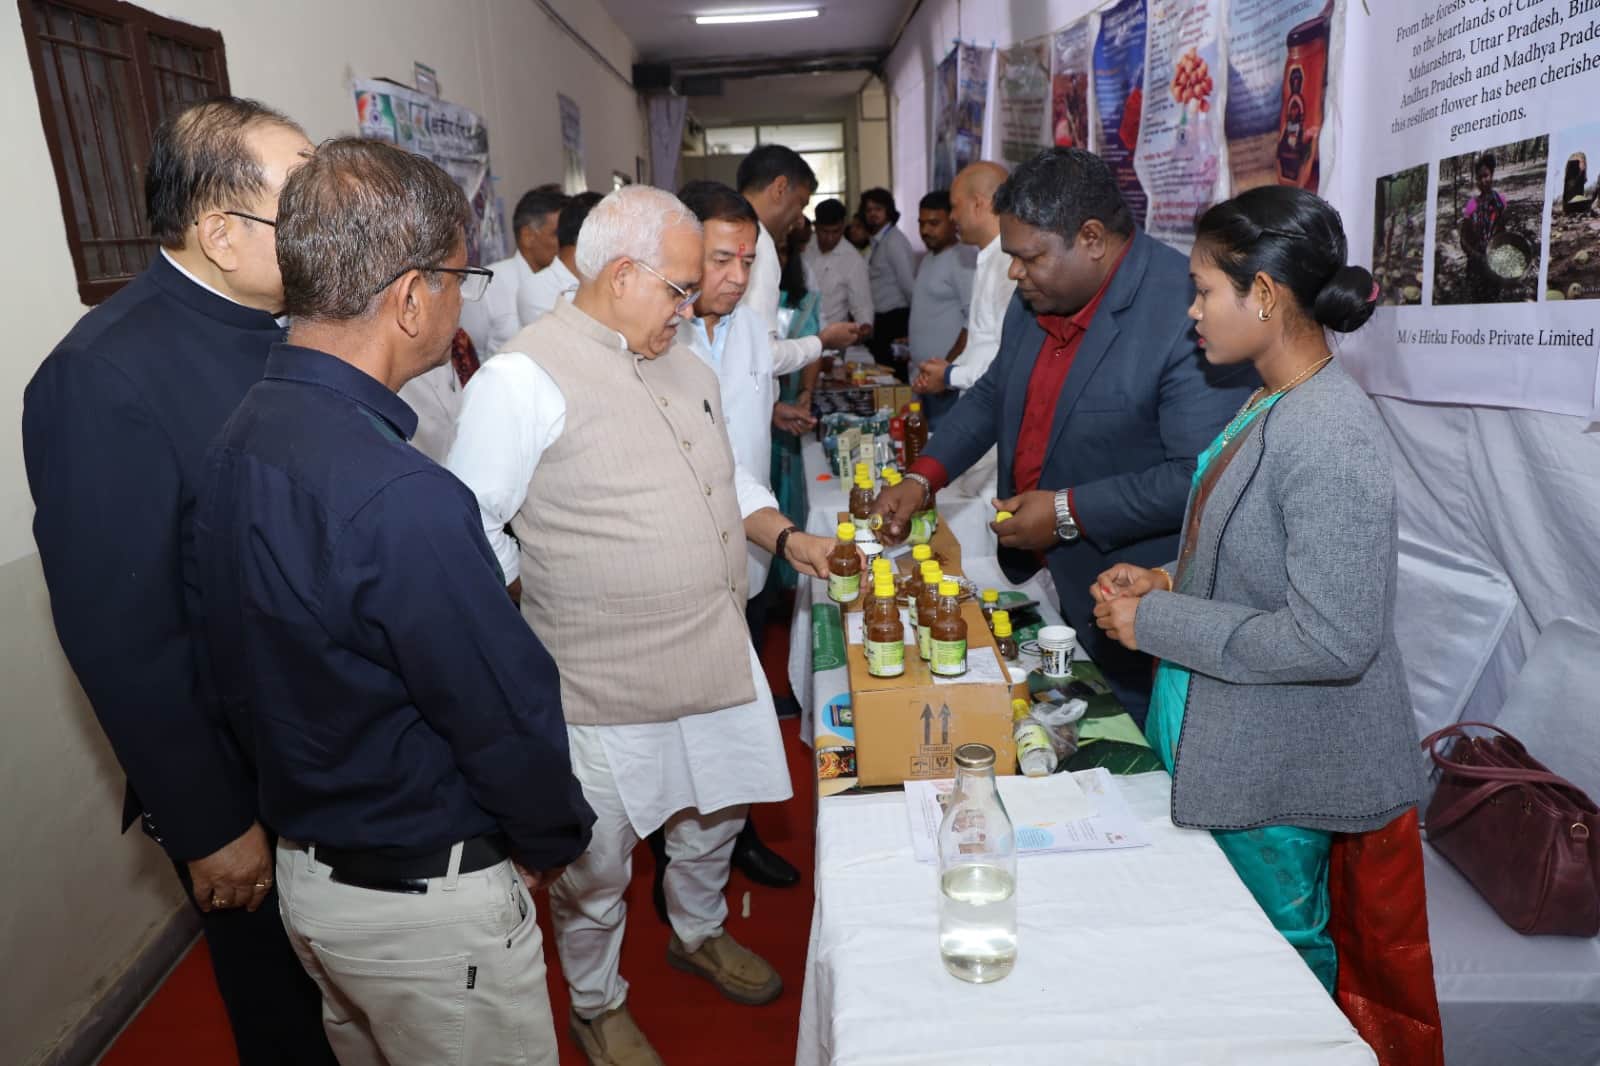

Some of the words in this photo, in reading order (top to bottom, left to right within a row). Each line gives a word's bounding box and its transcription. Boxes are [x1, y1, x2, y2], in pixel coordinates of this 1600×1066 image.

[1396, 22, 1419, 42] From
[1421, 12, 1435, 30] the
[1436, 0, 1466, 21] forests
[1409, 48, 1466, 82] Maharashtra,
[1470, 32, 1504, 55] Uttar
[1506, 7, 1564, 43] Pradesh,
[1412, 44, 1421, 57] to
[1423, 35, 1436, 52] the
[1437, 7, 1495, 45] heartlands
[1499, 0, 1512, 18] of
[1400, 85, 1429, 109] Andhra
[1430, 66, 1472, 96] Pradesh
[1475, 55, 1499, 79] and
[1503, 42, 1555, 71] Madhya
[1391, 117, 1406, 134] this
[1406, 106, 1439, 129] resilient
[1440, 94, 1479, 116] flower
[1481, 86, 1502, 104] has
[1505, 79, 1537, 96] been
[1450, 107, 1527, 142] generations.
[1397, 330, 1417, 344] M/s
[1418, 329, 1448, 344] Hitku
[1451, 328, 1486, 345] Foods
[1489, 329, 1534, 346] Private
[1538, 327, 1594, 347] Limited
